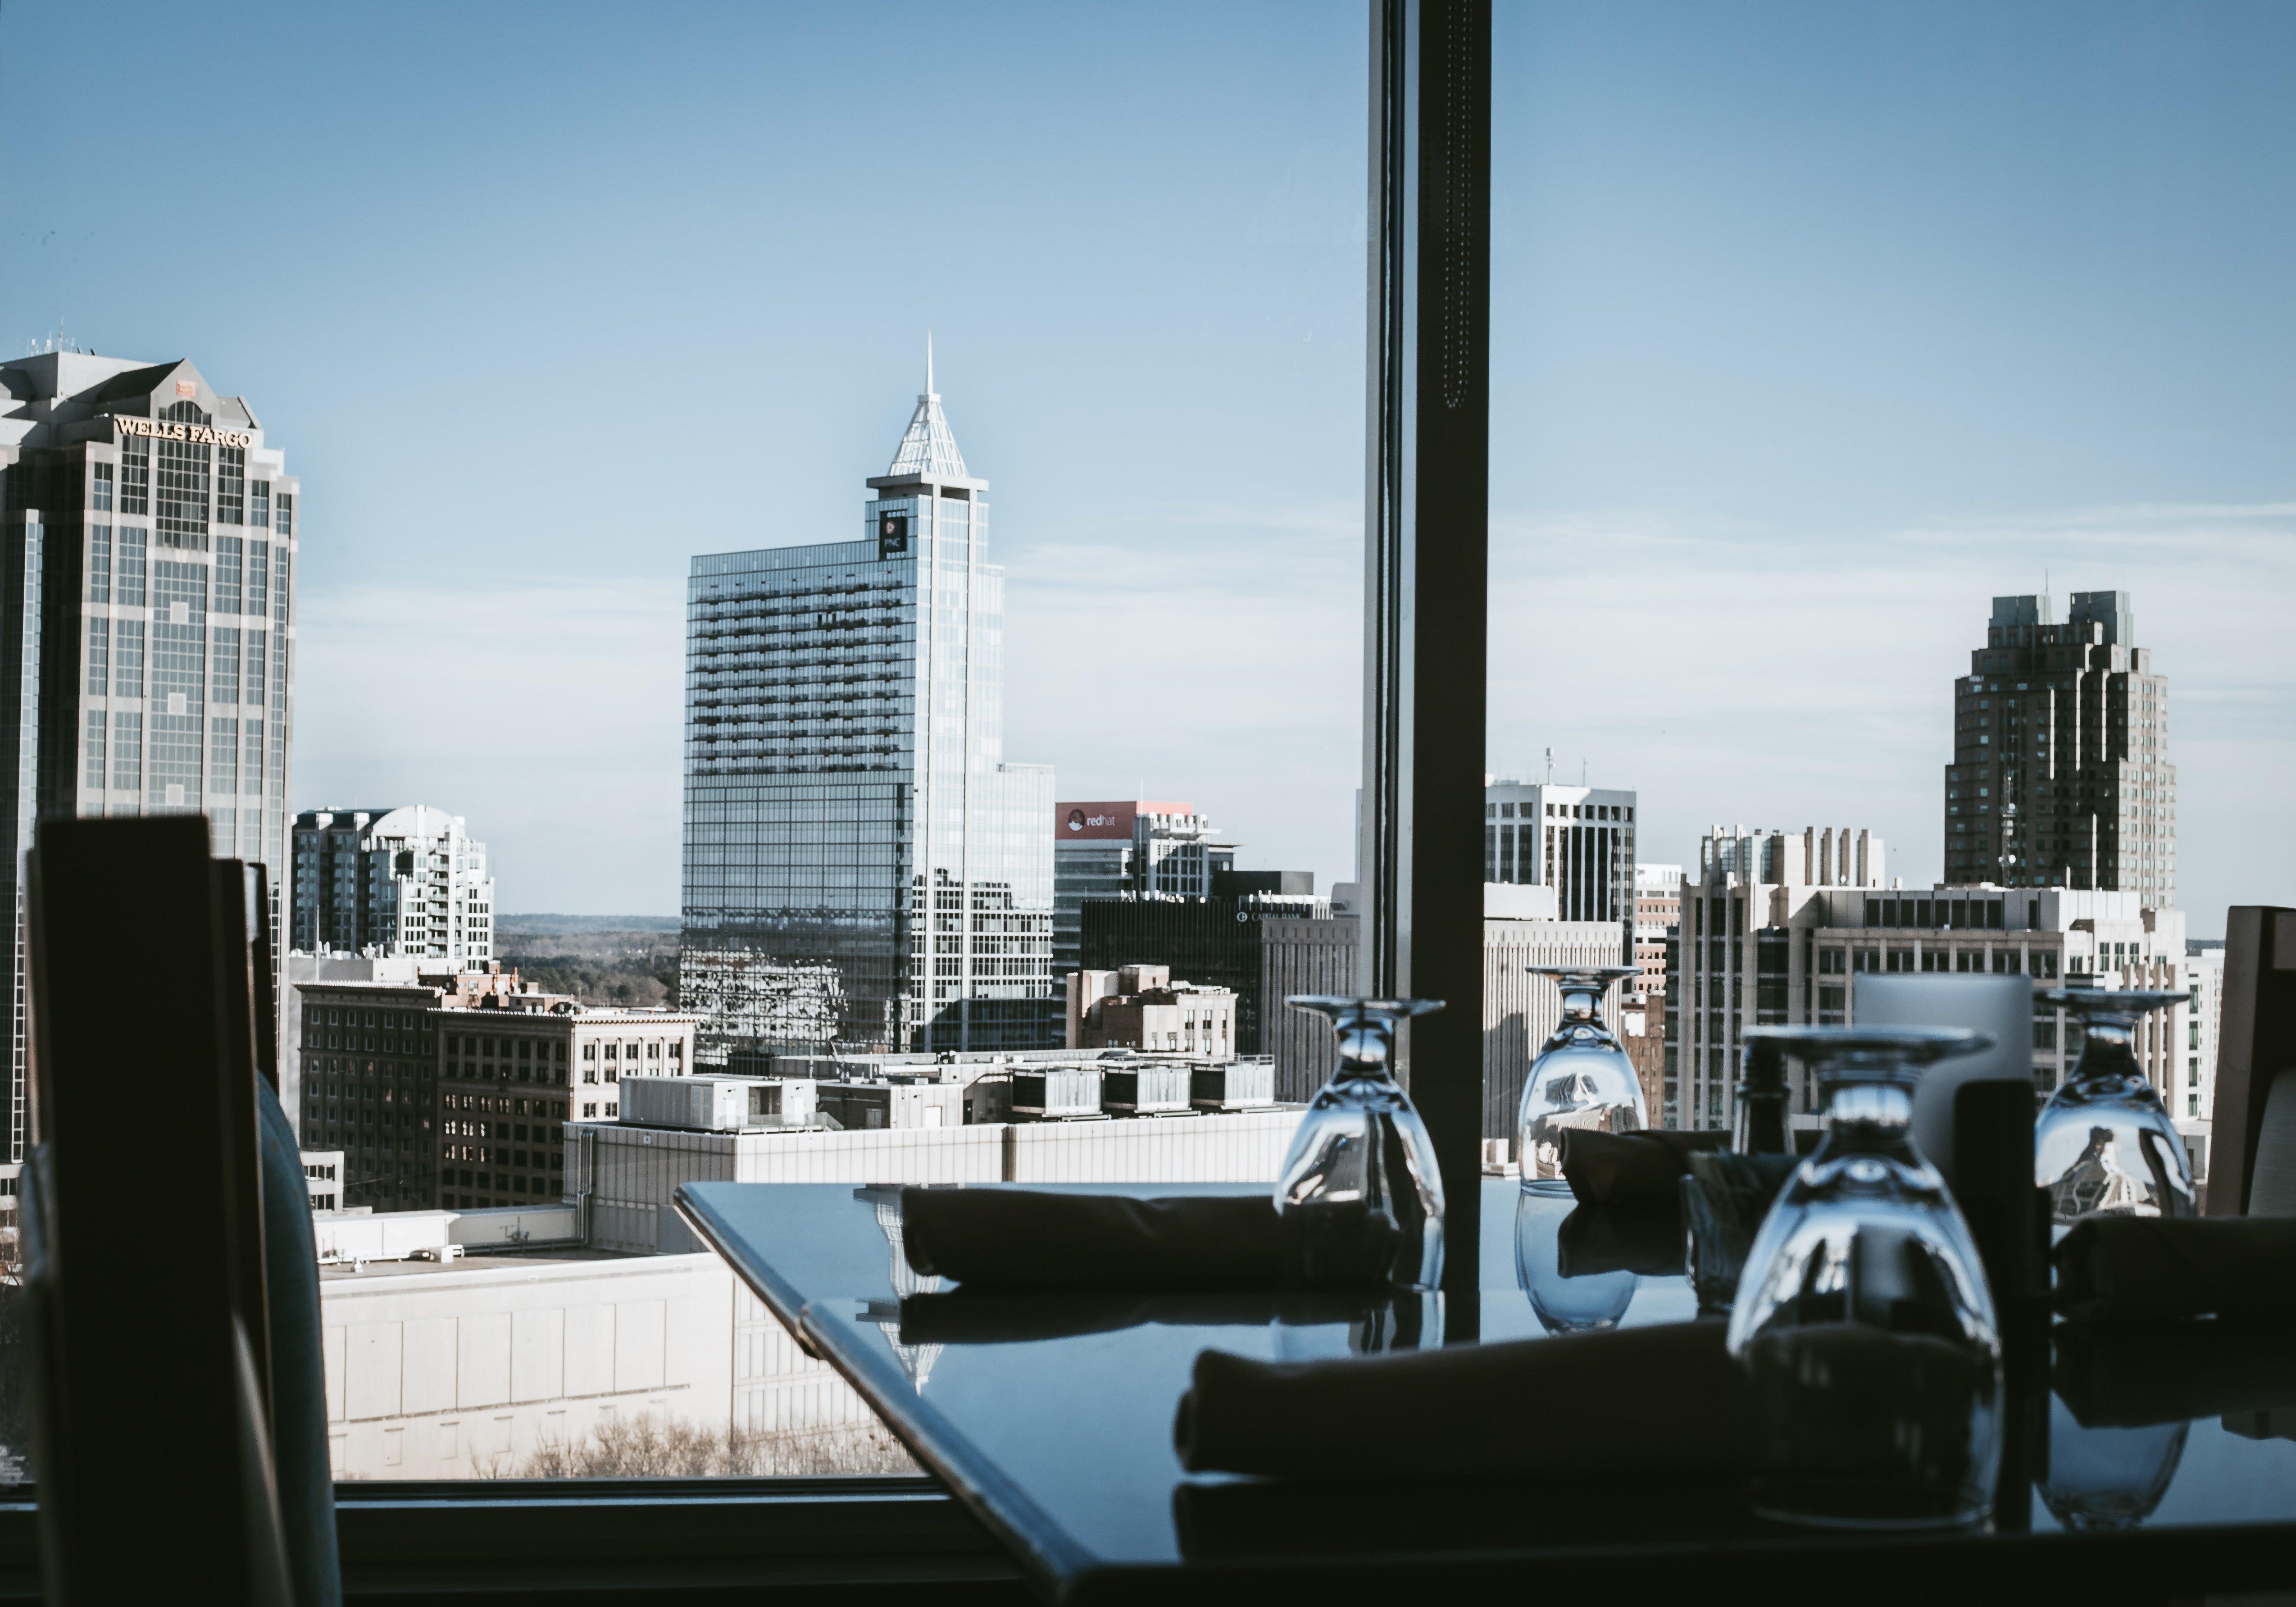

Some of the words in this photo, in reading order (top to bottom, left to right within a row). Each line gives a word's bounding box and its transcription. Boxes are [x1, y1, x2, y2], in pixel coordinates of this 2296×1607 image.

[115, 417, 185, 440] WELLS
[189, 425, 252, 448] FARGO
[884, 537, 900, 547] PNC
